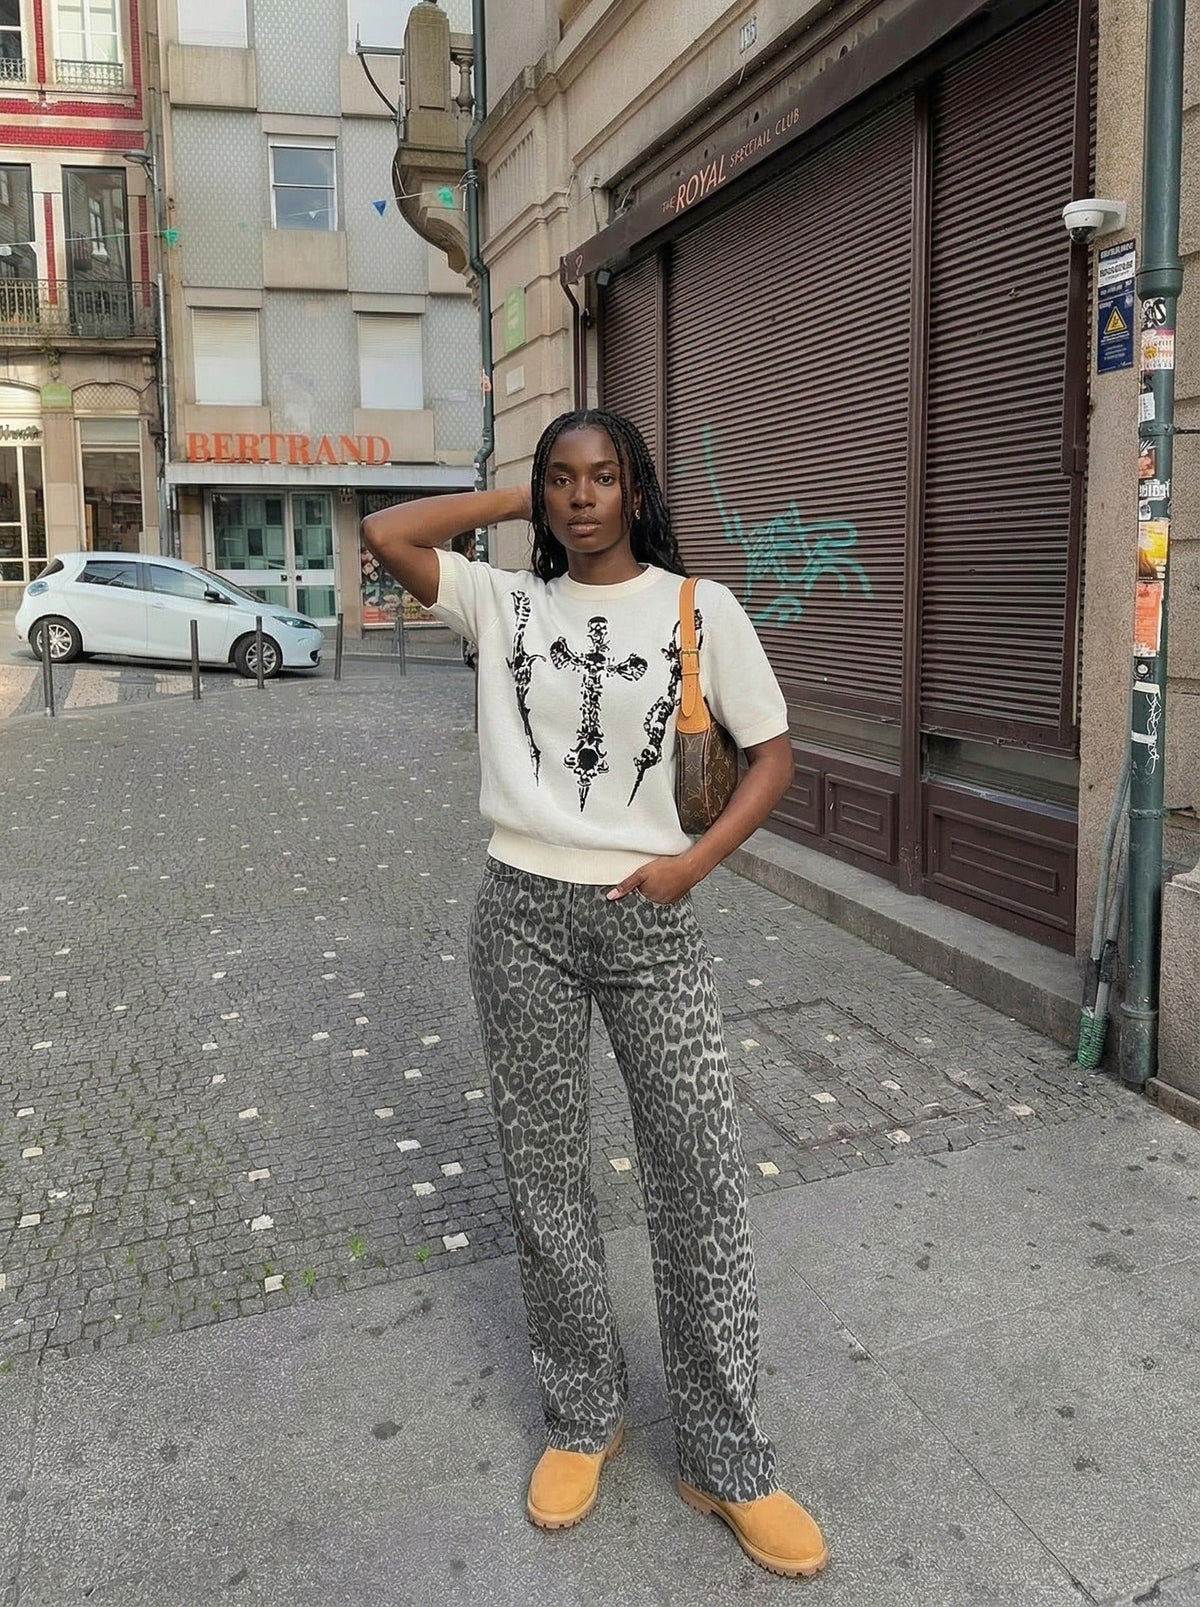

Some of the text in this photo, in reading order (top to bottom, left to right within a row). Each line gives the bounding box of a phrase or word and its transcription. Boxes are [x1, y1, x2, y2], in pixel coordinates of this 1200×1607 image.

[675, 154, 727, 213] ROYAL
[775, 107, 800, 135] CLUB
[184, 431, 393, 465] BERTRAND
